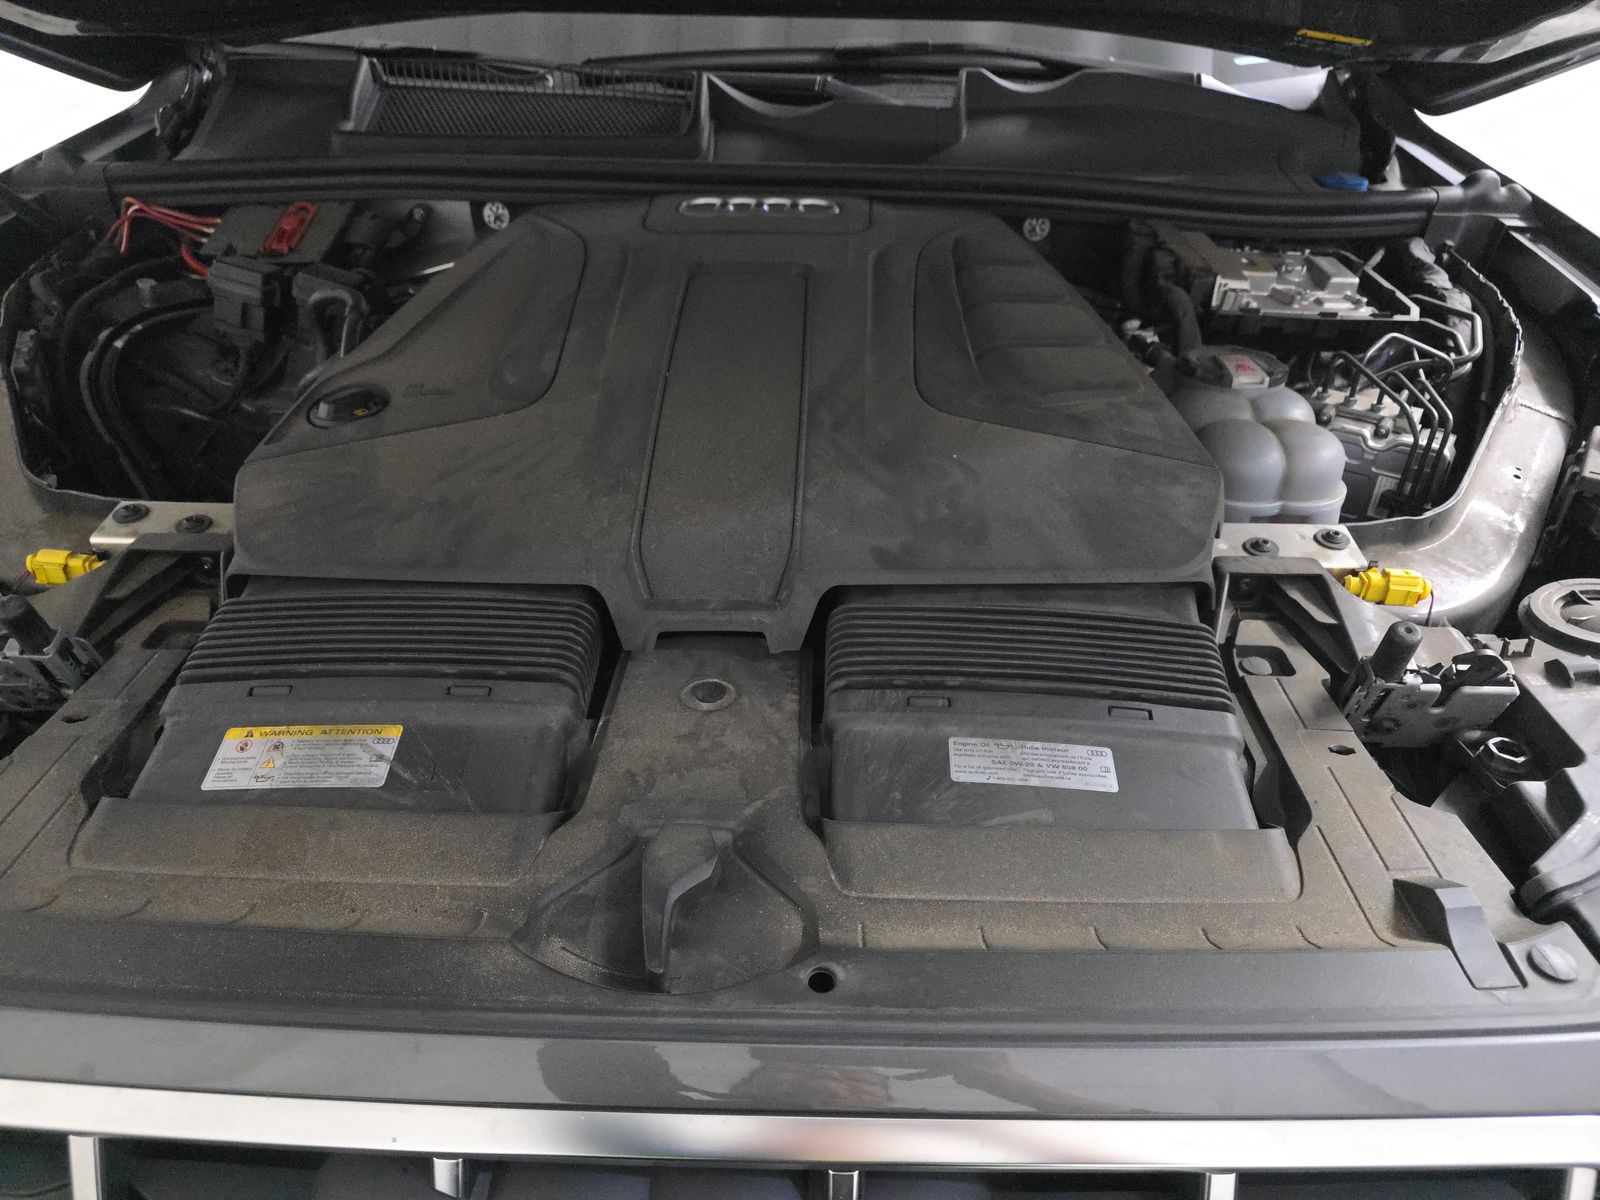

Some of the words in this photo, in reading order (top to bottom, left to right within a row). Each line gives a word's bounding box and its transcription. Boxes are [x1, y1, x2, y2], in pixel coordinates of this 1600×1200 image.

[259, 729, 313, 737] WARNING
[319, 728, 383, 736] ATTENTION
[1009, 760, 1034, 768] 0W-20
